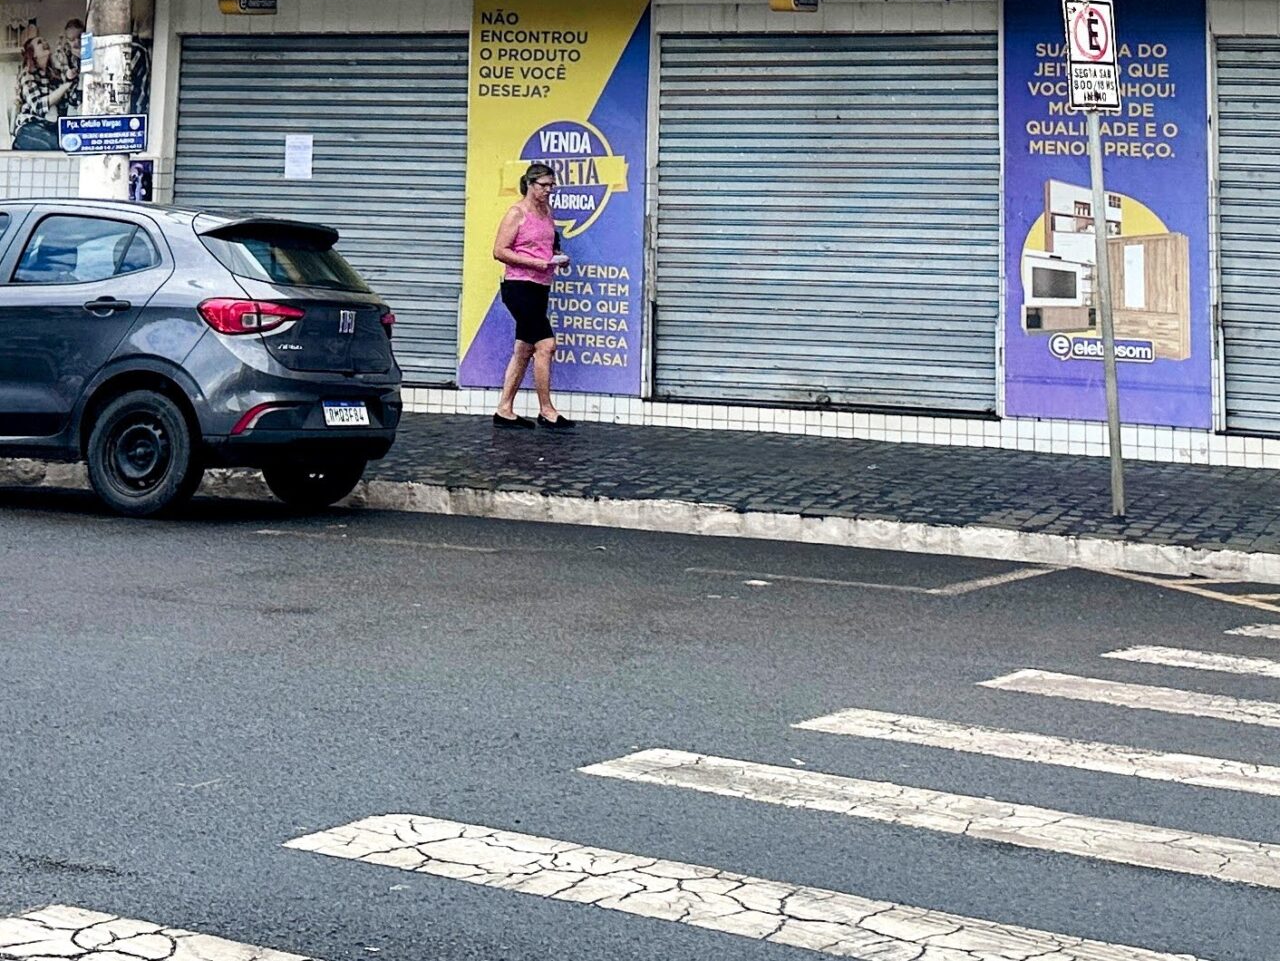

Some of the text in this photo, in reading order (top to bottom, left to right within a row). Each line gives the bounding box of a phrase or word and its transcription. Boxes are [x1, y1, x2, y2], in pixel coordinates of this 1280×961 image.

[481, 9, 519, 25] NÃO
[480, 30, 588, 44] ENCONTROU
[480, 48, 581, 62] O PRODUTO
[1138, 43, 1167, 58] DO
[479, 64, 566, 80] QUE VOCÊ
[1128, 63, 1169, 77] QUE
[478, 84, 550, 98] DESEJA?
[1128, 103, 1154, 117] DE
[1145, 123, 1157, 137] E
[1163, 123, 1178, 138] O
[540, 131, 591, 153] VENDA
[1104, 141, 1176, 159] PREÇO.
[549, 189, 595, 210] FÁBRICA
[576, 265, 629, 280] VENDA
[550, 281, 629, 297] IRETA TEM
[548, 297, 629, 315] TUDO QUE
[564, 315, 628, 332] PRECISA
[555, 332, 628, 350] ENTREGA
[1053, 336, 1152, 359] e eletsom
[552, 350, 627, 367] UA CASA!
